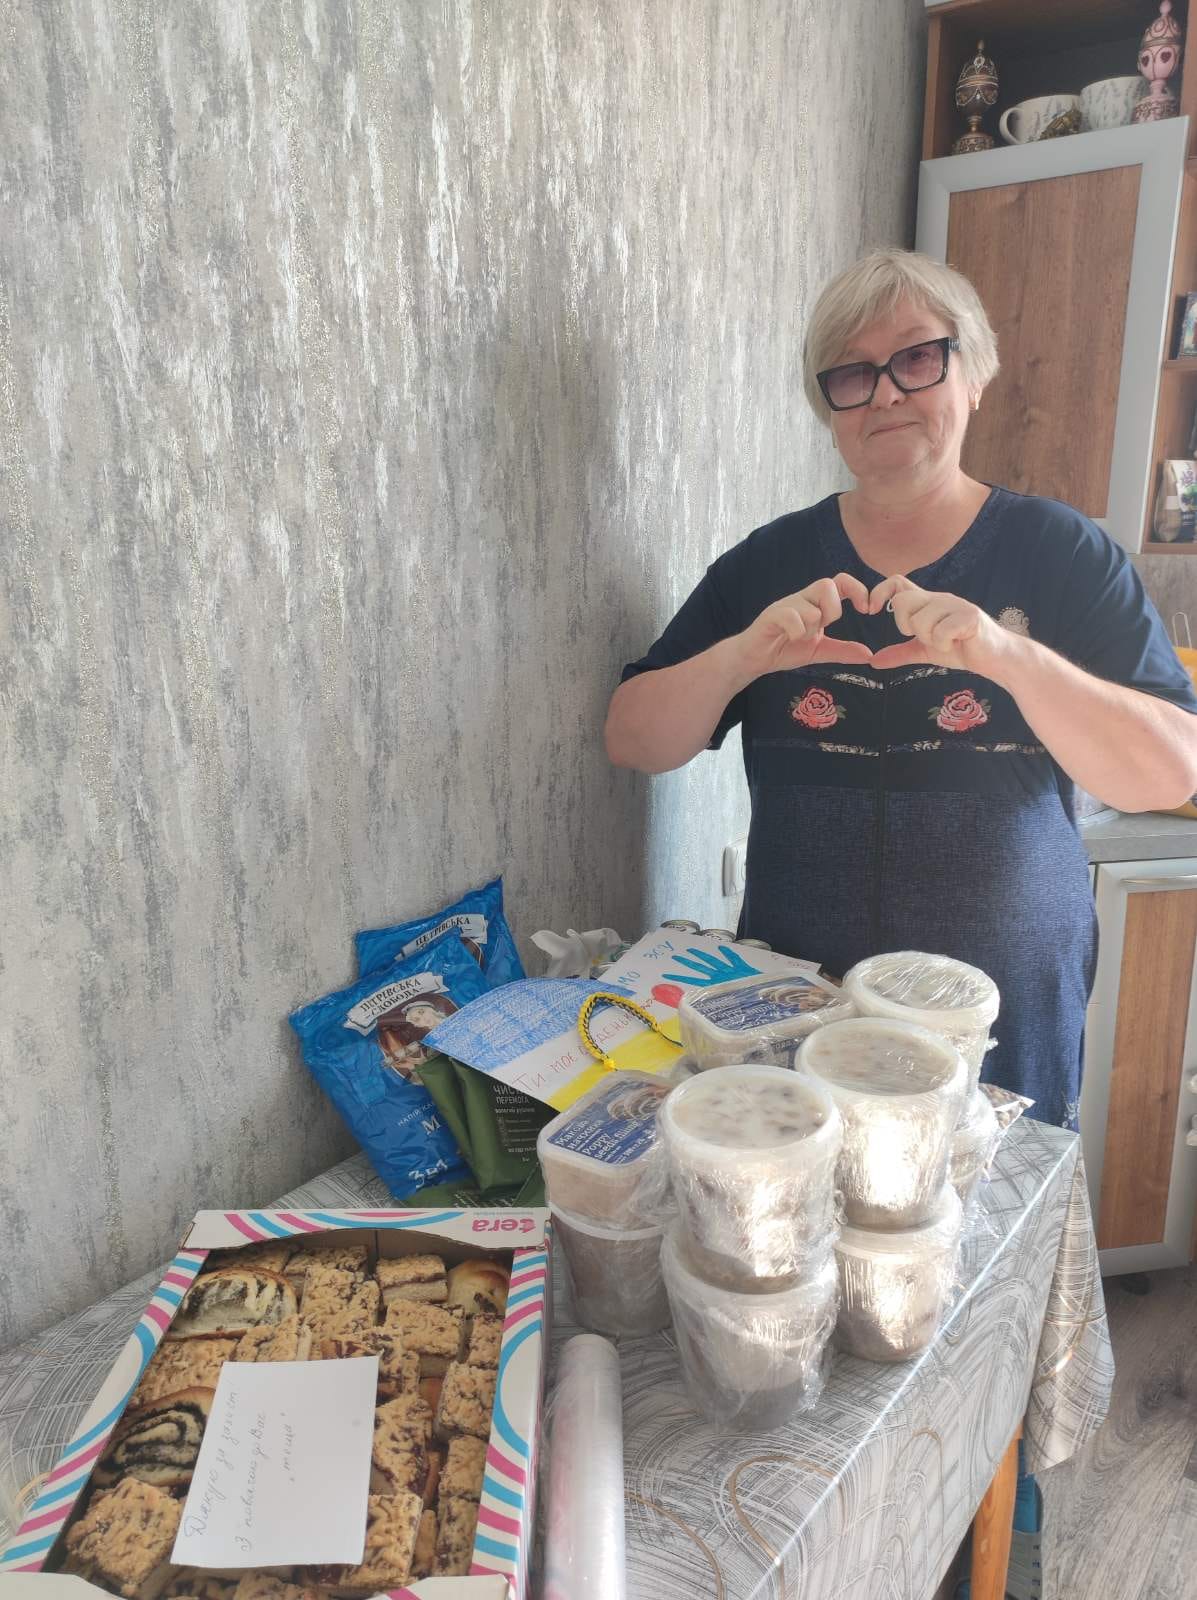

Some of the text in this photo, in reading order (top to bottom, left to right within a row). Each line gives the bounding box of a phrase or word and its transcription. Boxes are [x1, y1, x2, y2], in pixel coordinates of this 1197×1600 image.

[414, 916, 472, 946] ПЕТРІВСЬКА
[359, 977, 422, 1013] ПЕТРІВСЬКА
[370, 987, 420, 1017] СЛОБОДА
[582, 1132, 612, 1155] Poppy
[472, 1218, 536, 1233] tera
